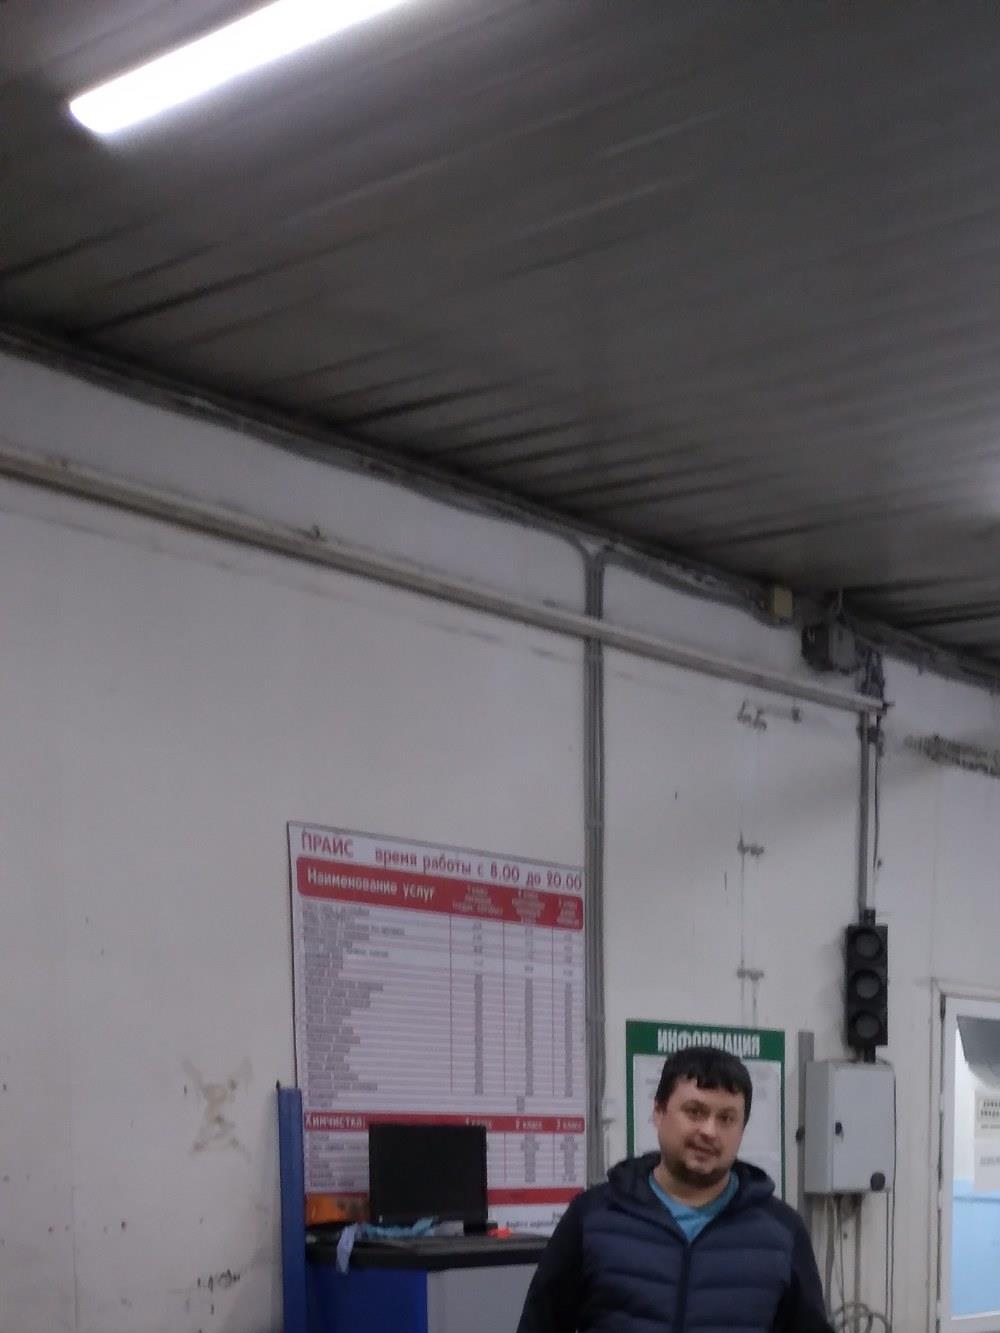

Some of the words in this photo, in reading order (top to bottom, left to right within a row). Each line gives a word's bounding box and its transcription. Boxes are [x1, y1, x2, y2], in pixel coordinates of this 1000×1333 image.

[301, 829, 354, 857] ПРАЙС
[375, 848, 417, 870] время
[423, 855, 471, 874] работы
[307, 867, 398, 896] Наименование
[403, 883, 435, 903] услуг
